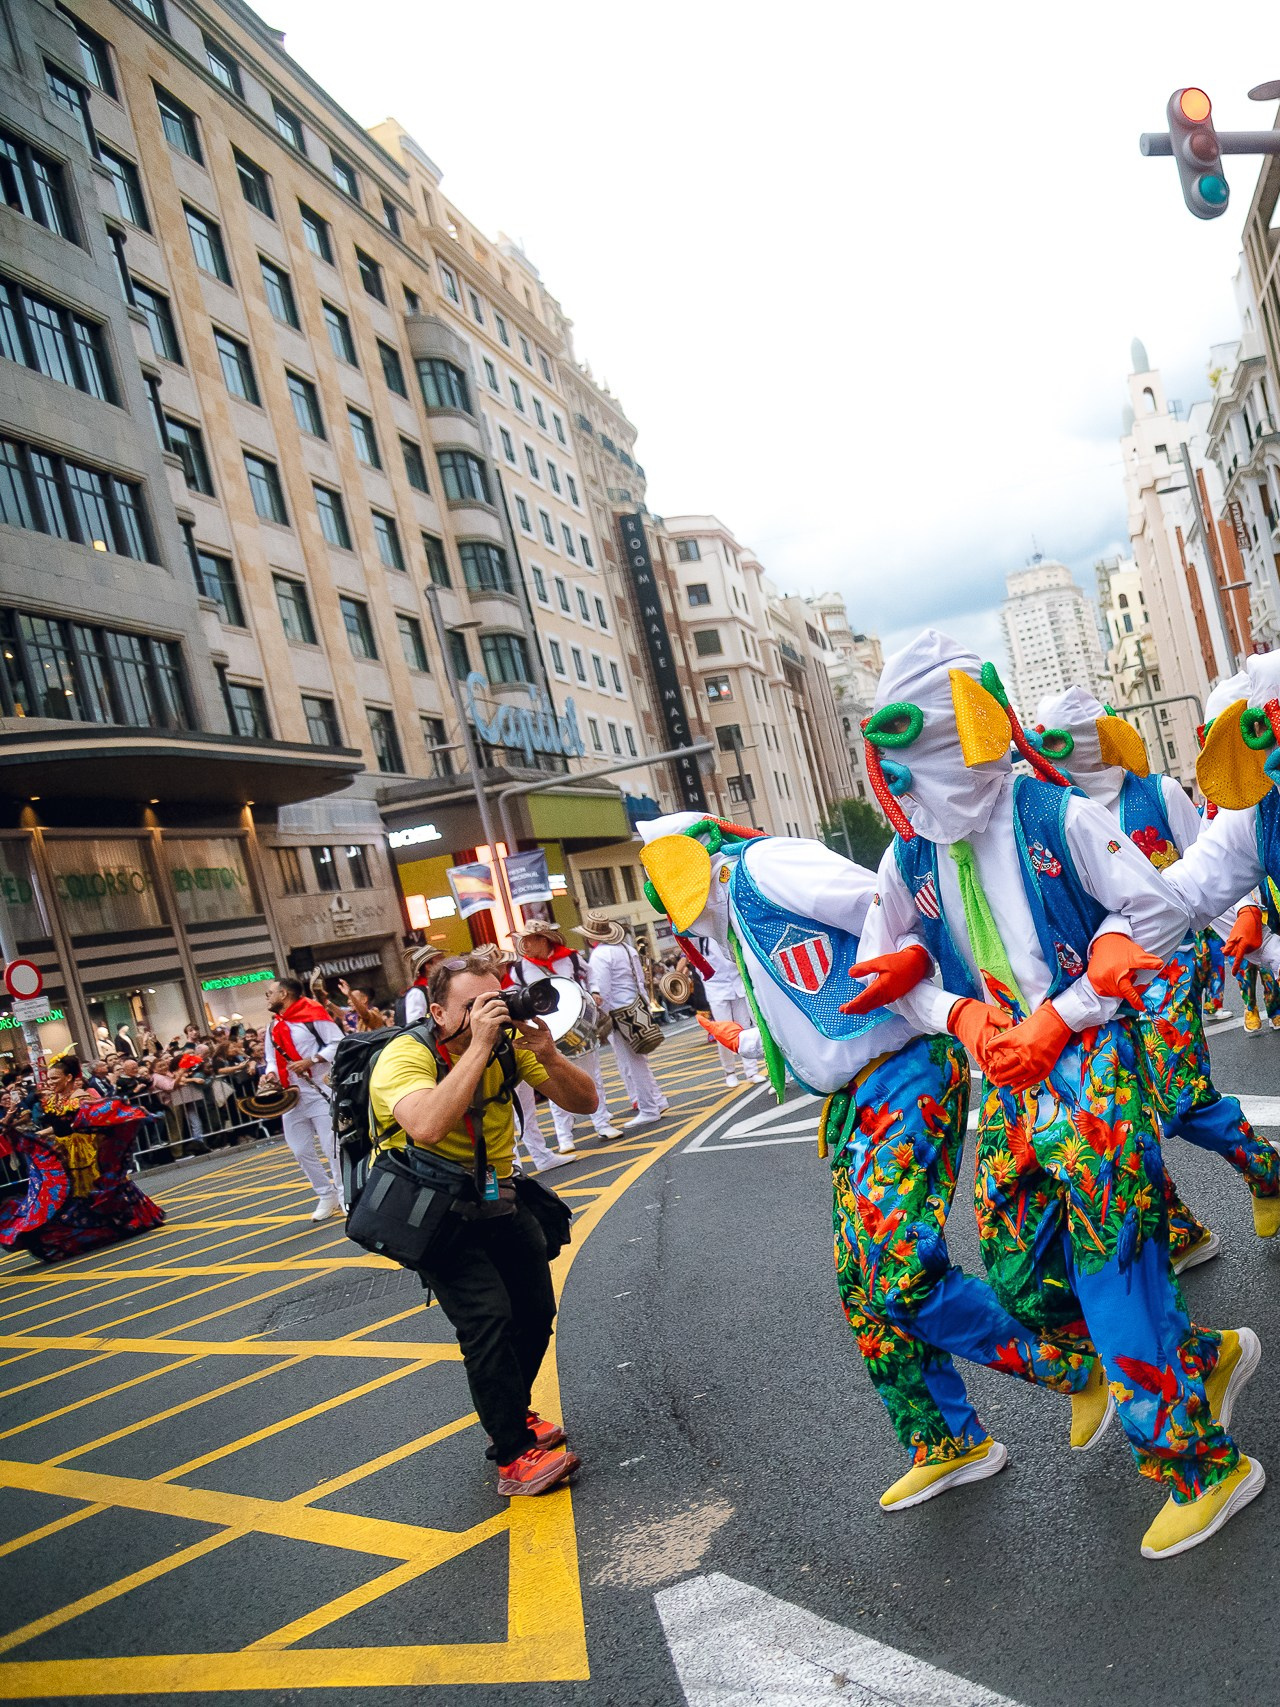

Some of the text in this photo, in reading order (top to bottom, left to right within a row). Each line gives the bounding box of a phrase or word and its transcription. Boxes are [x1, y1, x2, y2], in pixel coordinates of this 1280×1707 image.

[626, 521, 650, 585] ROOM
[645, 605, 668, 669] MATE
[466, 671, 585, 764] Capitol
